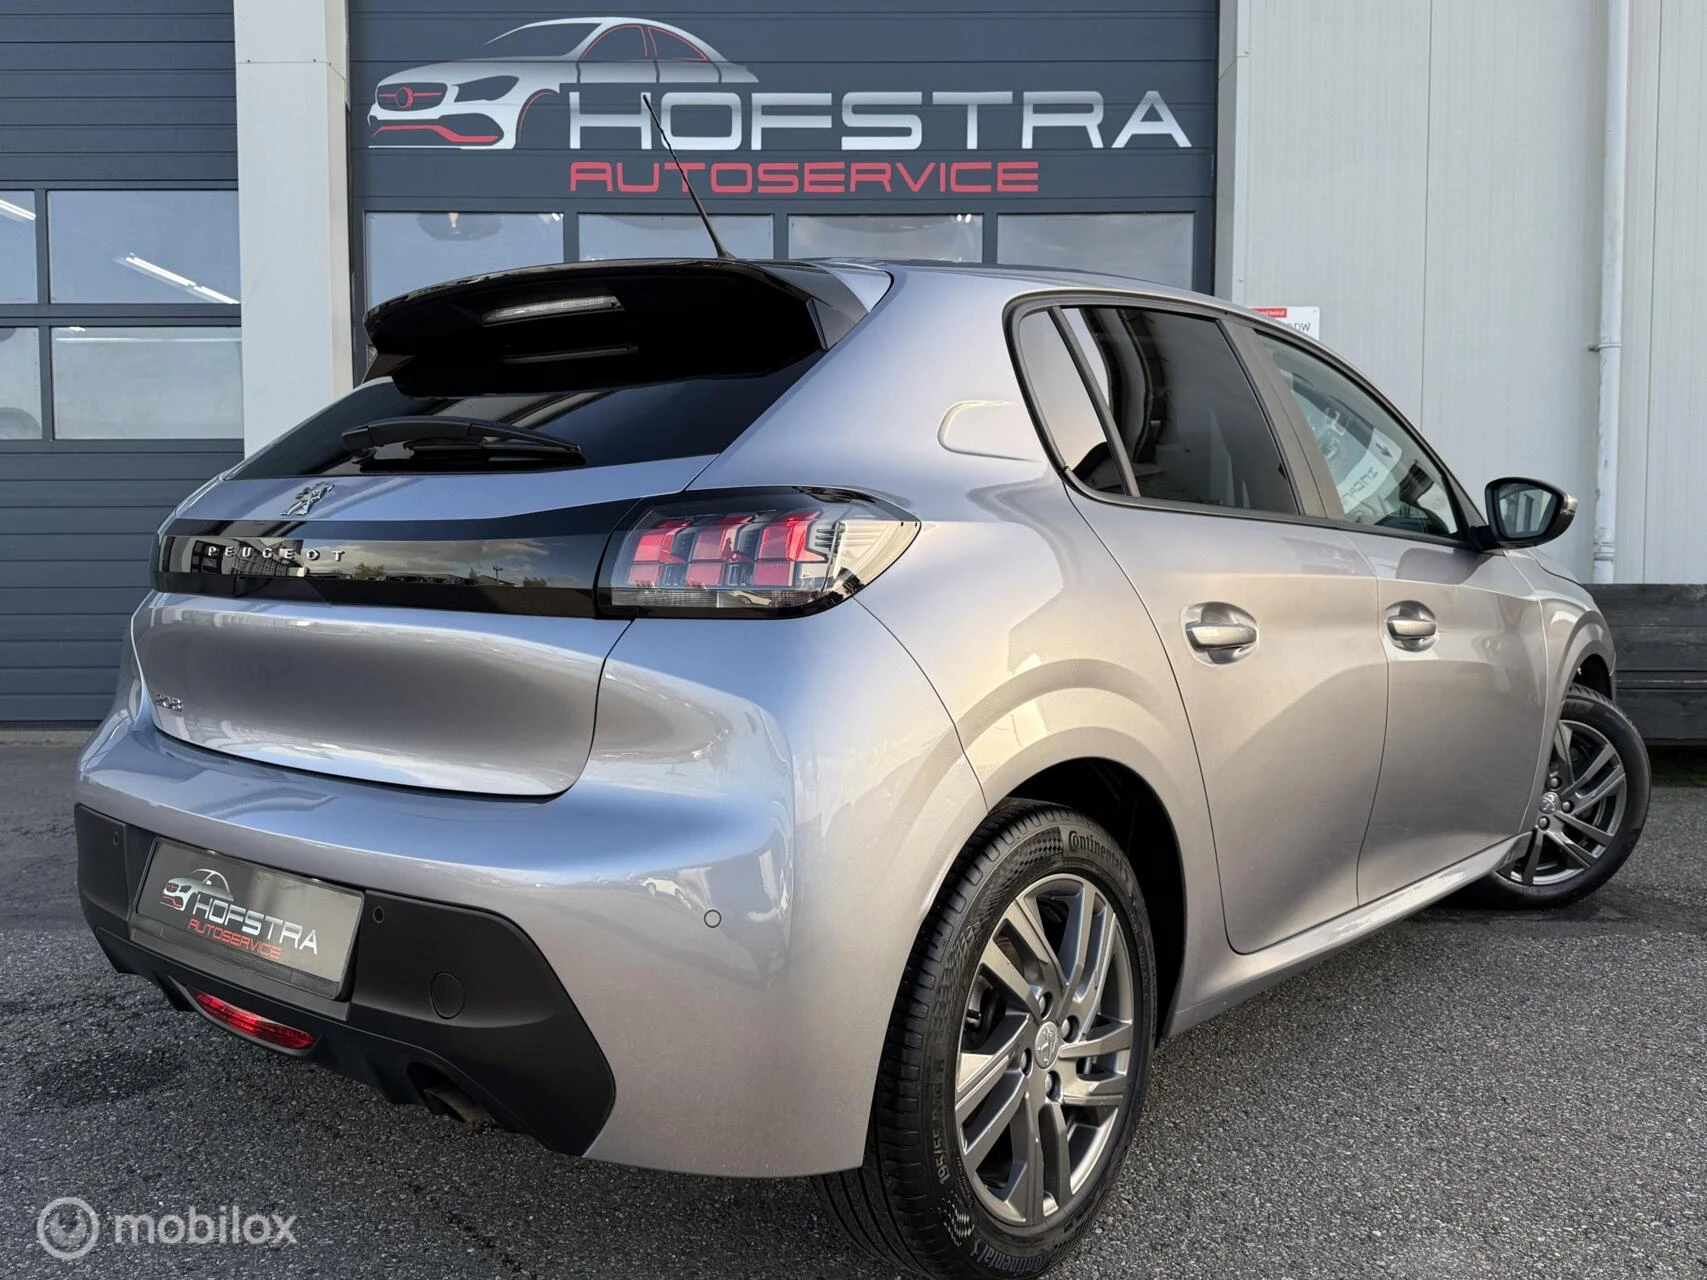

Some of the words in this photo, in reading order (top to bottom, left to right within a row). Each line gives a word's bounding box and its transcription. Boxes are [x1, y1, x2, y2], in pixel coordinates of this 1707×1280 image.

[569, 90, 1192, 151] HOFSTRA
[569, 162, 1039, 193] AUTOSERVICE
[207, 546, 345, 562] PEUGEOT
[1068, 830, 1123, 876] Continental
[188, 918, 284, 960] AUTOSERVICE
[193, 893, 318, 955] HOFSTRA
